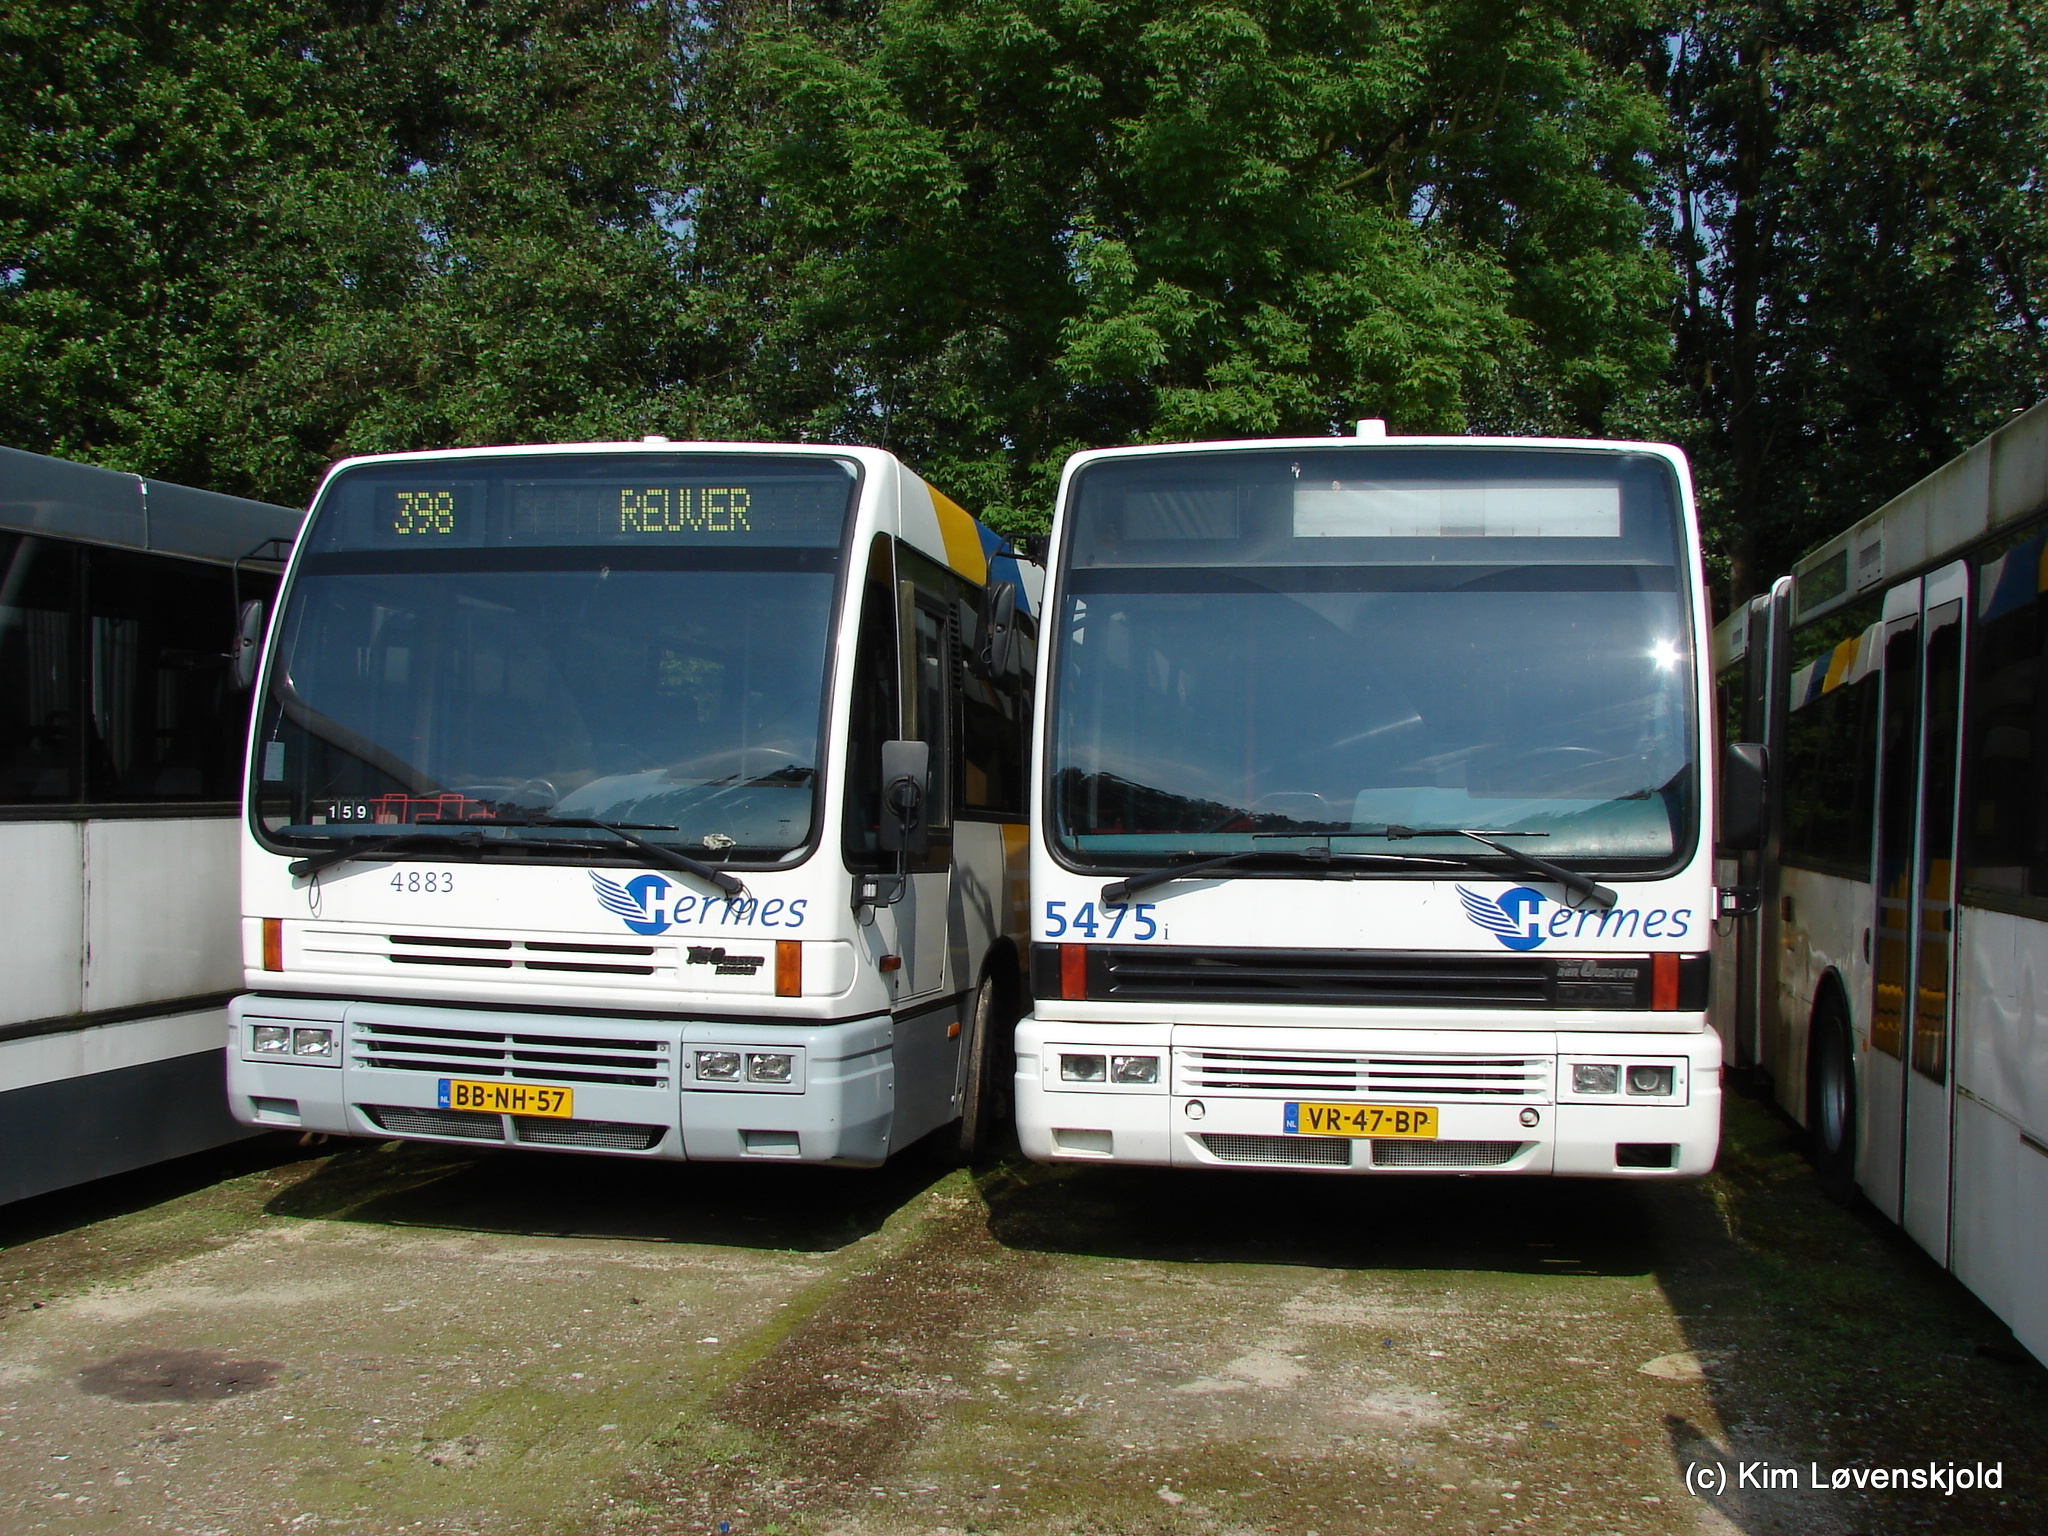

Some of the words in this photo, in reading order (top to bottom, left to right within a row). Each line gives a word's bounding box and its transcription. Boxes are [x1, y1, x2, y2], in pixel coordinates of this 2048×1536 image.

[394, 491, 454, 534] 398
[621, 488, 751, 532] REUVER
[328, 805, 367, 819] 159
[390, 871, 453, 893] 4883
[645, 885, 808, 928] Hermes
[1045, 901, 1157, 941] 5475
[1518, 899, 1693, 939] Hermes
[456, 1084, 565, 1112] BB-NH-57
[1286, 1120, 1297, 1128] NL
[1308, 1107, 1428, 1133] VR-47-BP
